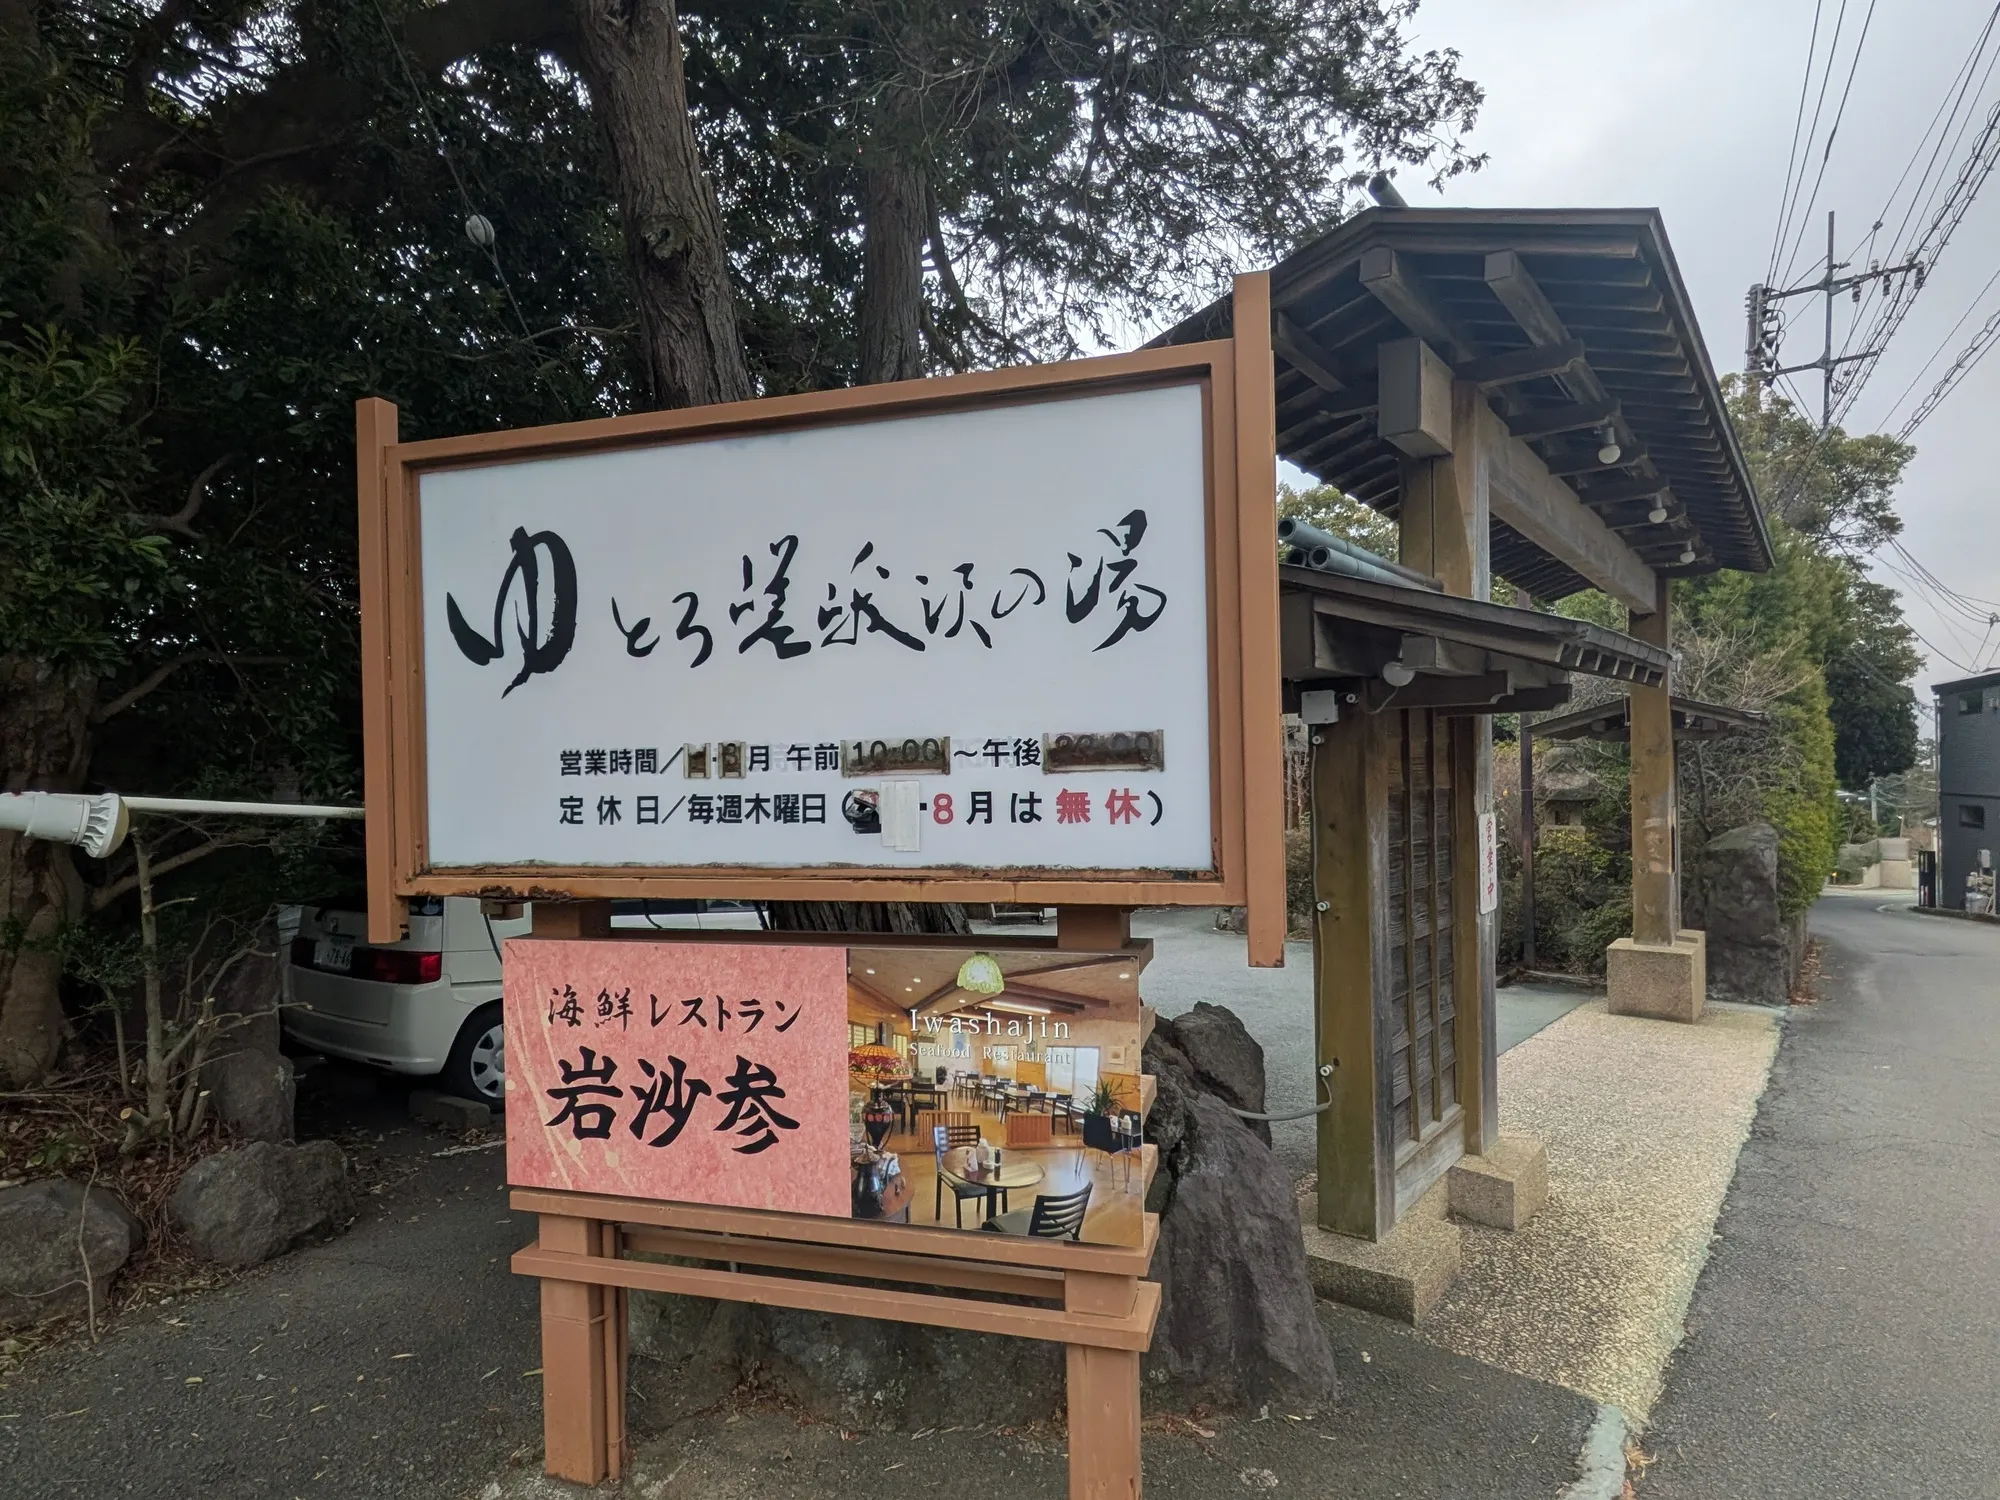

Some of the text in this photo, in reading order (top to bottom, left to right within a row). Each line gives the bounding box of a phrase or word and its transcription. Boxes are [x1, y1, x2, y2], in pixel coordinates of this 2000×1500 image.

[909, 1008, 1071, 1044] Iwashajin
[909, 1042, 1071, 1065] Seafood Restaurant
[545, 1046, 801, 1155] 岩沙参
